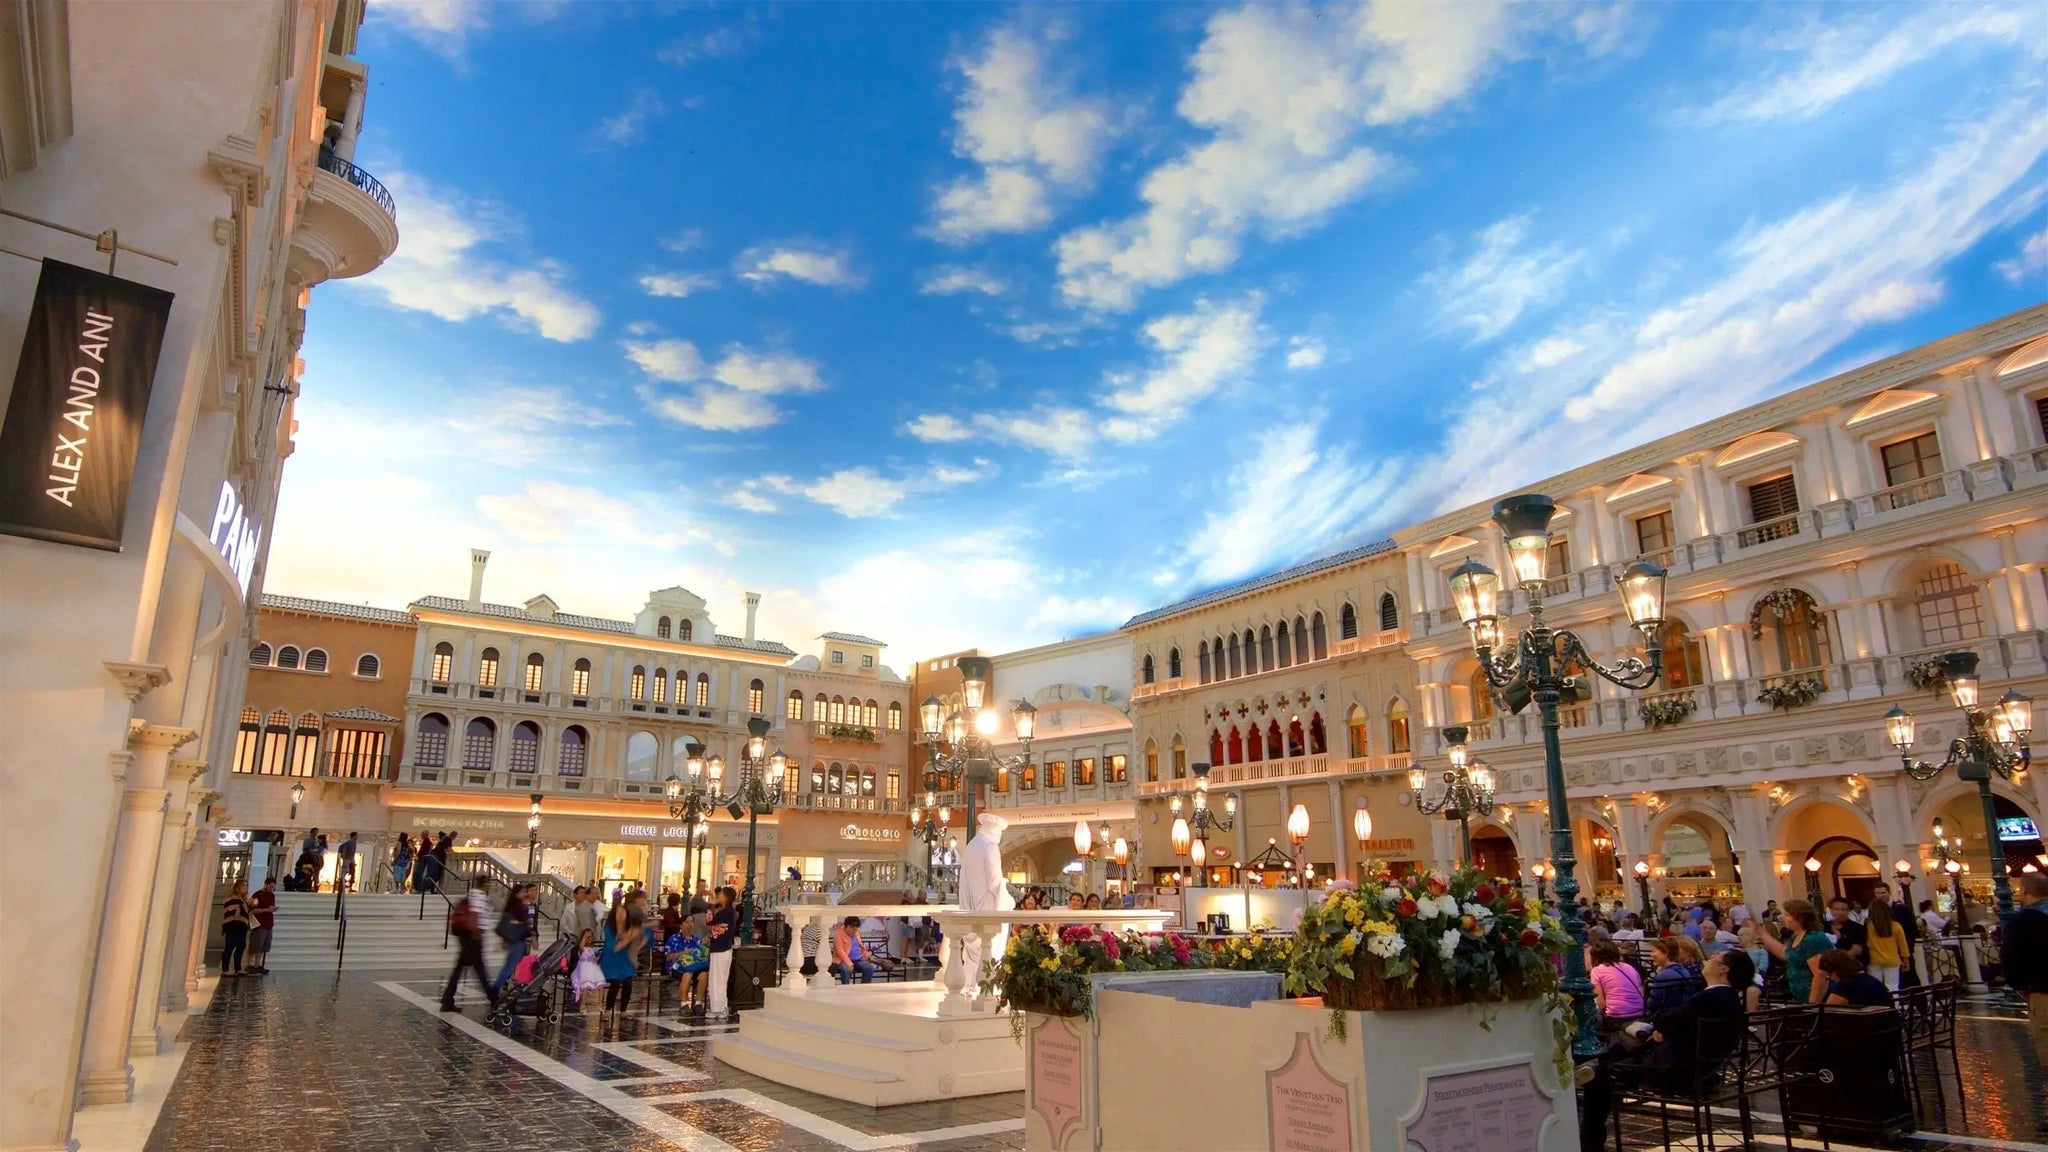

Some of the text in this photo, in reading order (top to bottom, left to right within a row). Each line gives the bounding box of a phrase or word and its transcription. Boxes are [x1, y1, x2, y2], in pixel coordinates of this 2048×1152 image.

[46, 311, 114, 508] ALEX AND ANI
[1276, 1086, 1289, 1096] THE
[1290, 1088, 1325, 1101] VENETIAN
[1325, 1094, 1343, 1105] TRIO
